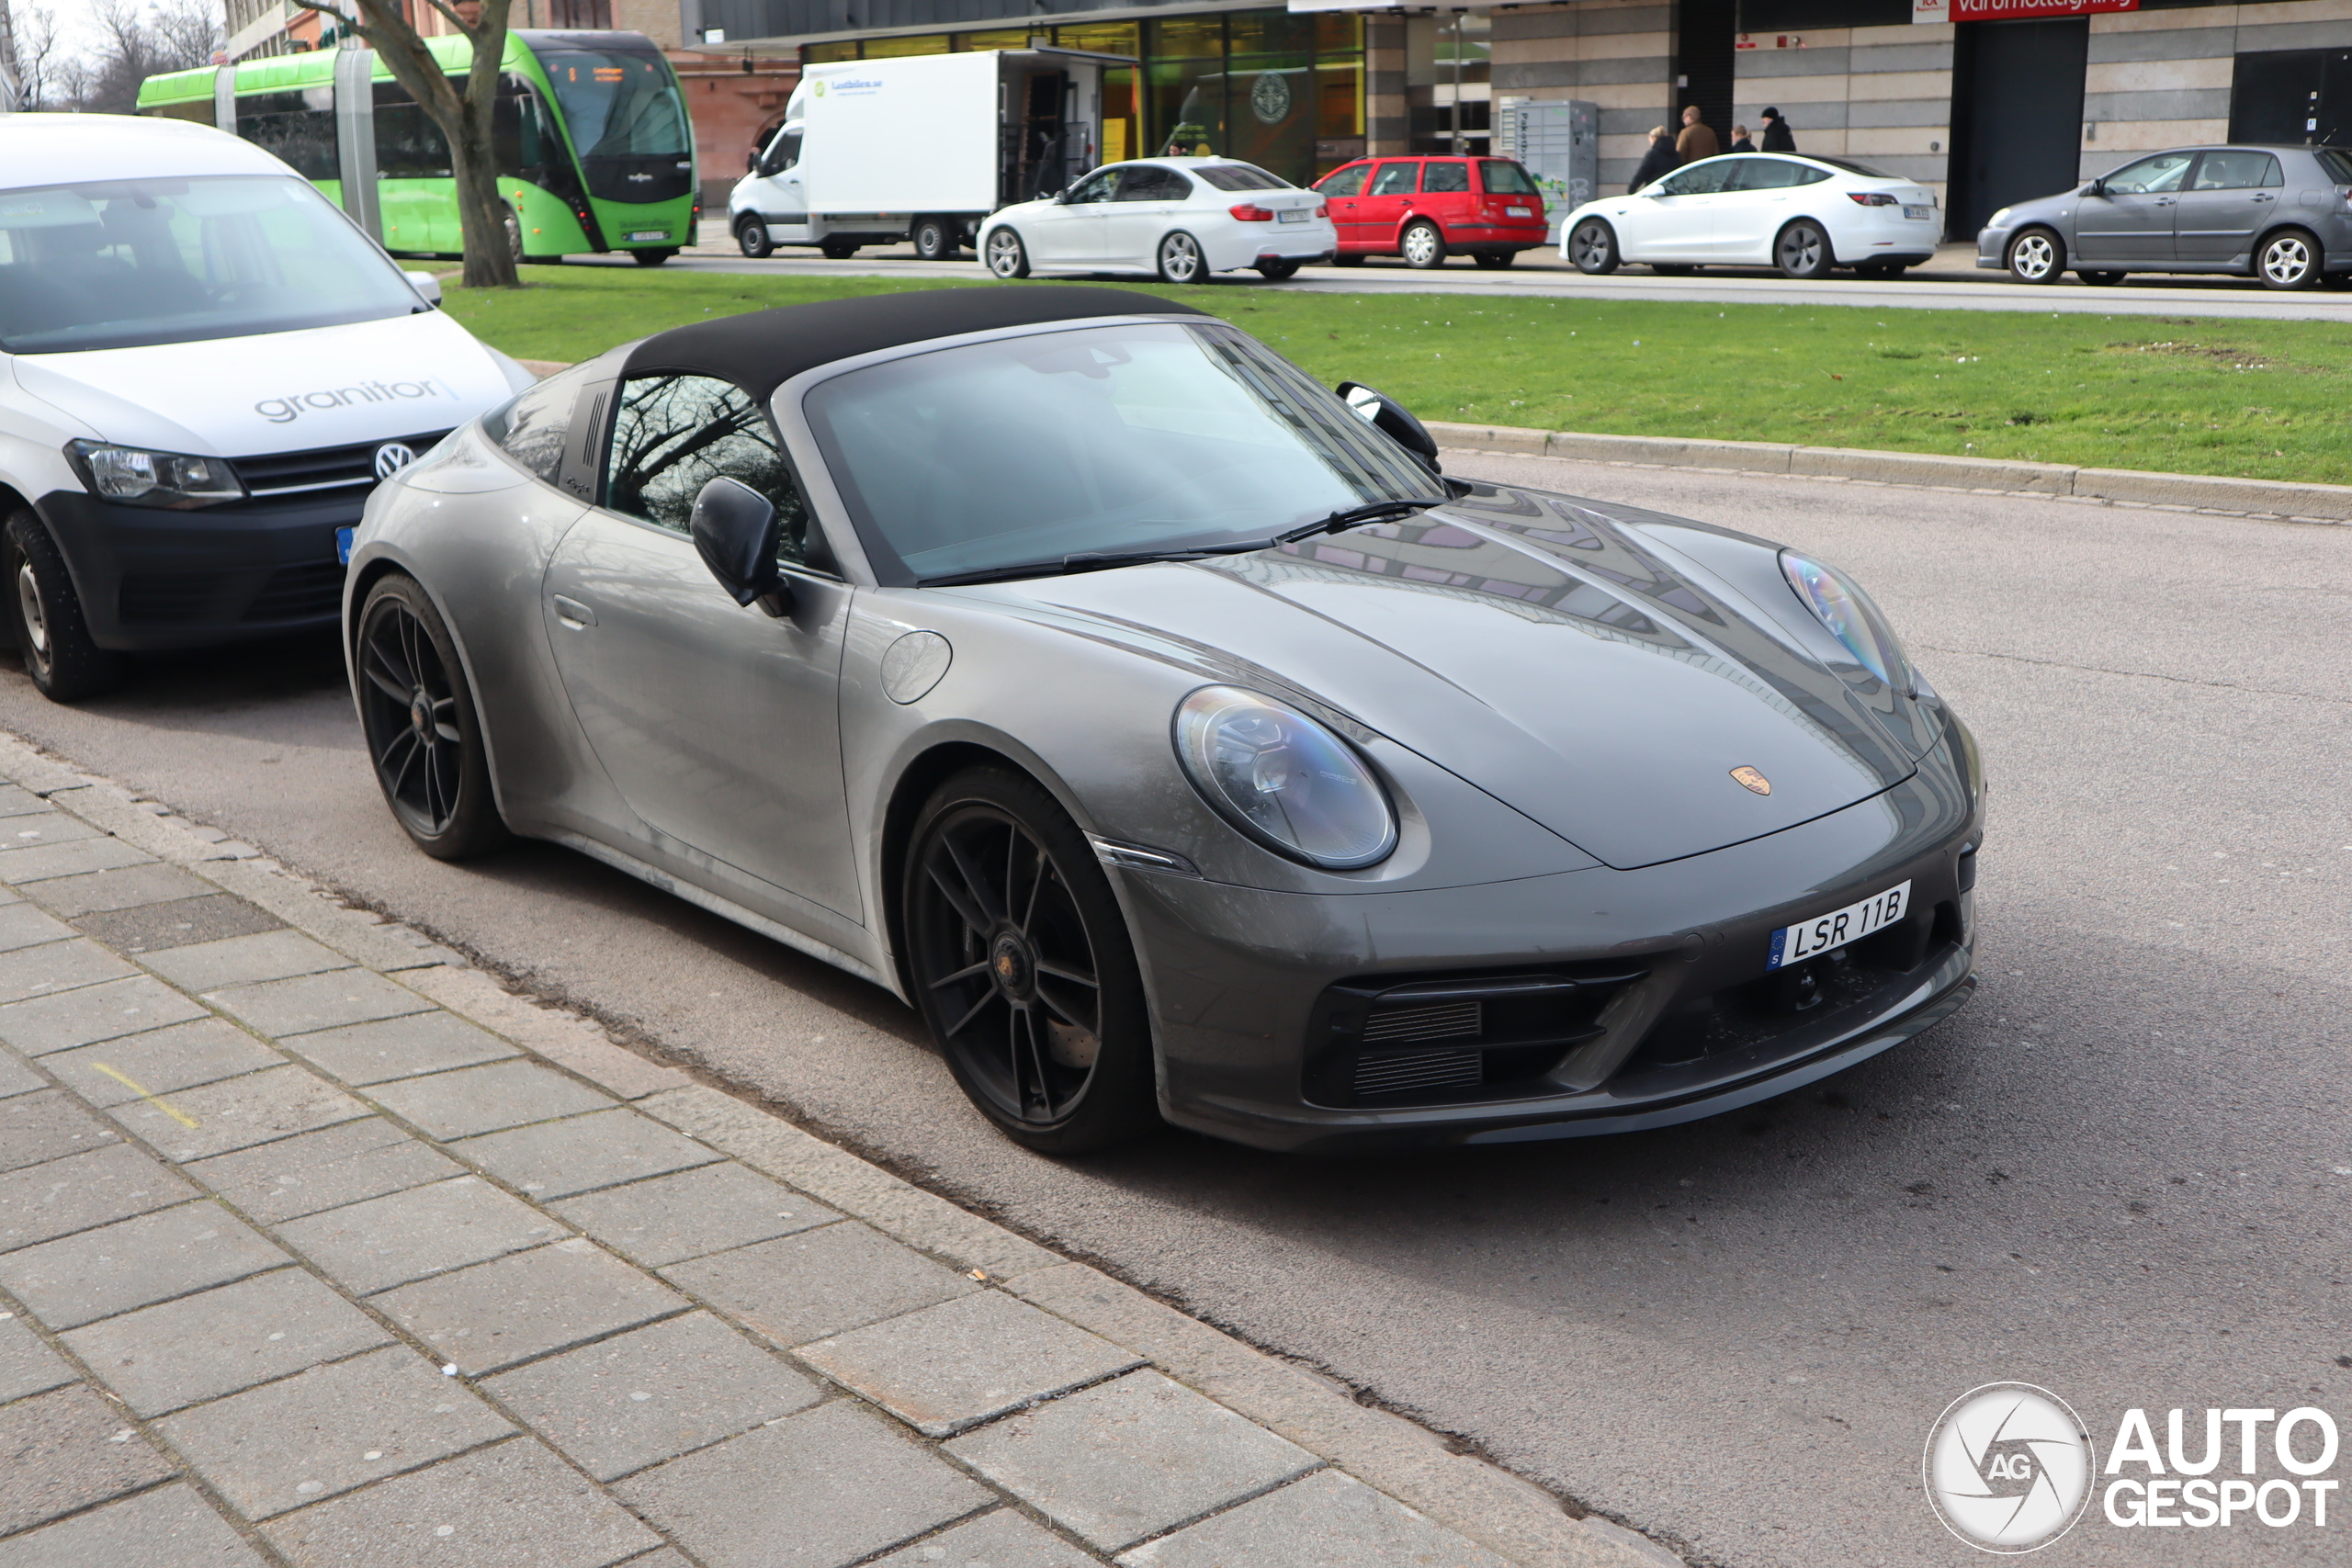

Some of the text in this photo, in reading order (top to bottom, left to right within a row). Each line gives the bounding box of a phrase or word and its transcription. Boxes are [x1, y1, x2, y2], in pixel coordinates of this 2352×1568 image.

[254, 380, 437, 423] granitor
[1794, 890, 1901, 958] LSR 11B
